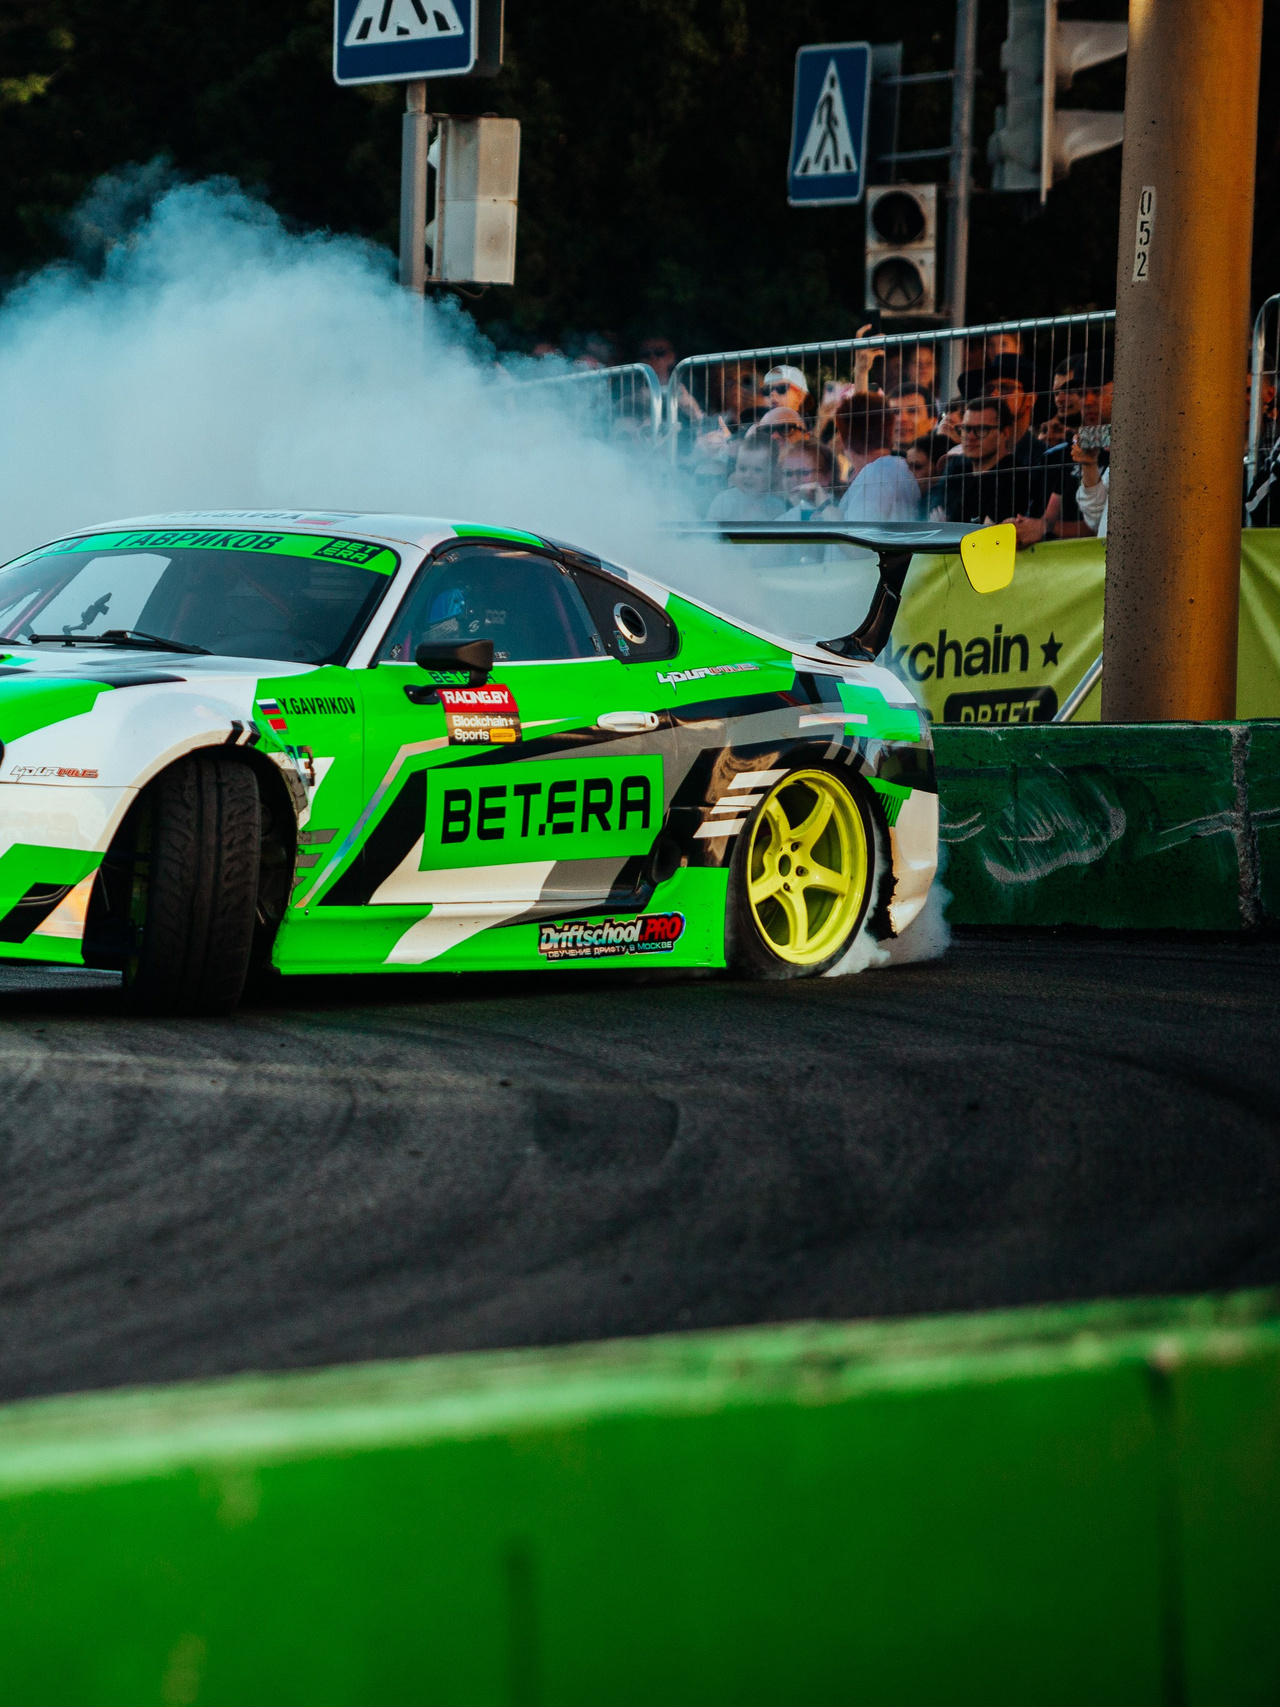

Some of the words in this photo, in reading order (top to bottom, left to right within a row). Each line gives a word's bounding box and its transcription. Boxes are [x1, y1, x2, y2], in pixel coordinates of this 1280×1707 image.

[1136, 190, 1152, 277] 052
[112, 532, 286, 550] ГАВРИКОВ
[331, 540, 380, 553] BET
[876, 624, 1029, 682] kchain
[277, 696, 356, 715] Y.GAVRIKOV
[442, 690, 509, 704] RACING.BY
[452, 715, 508, 727] Blockchain
[454, 728, 490, 742] Sports
[441, 775, 651, 844] BET.ERA
[540, 917, 682, 949] Driftschool.PRO
